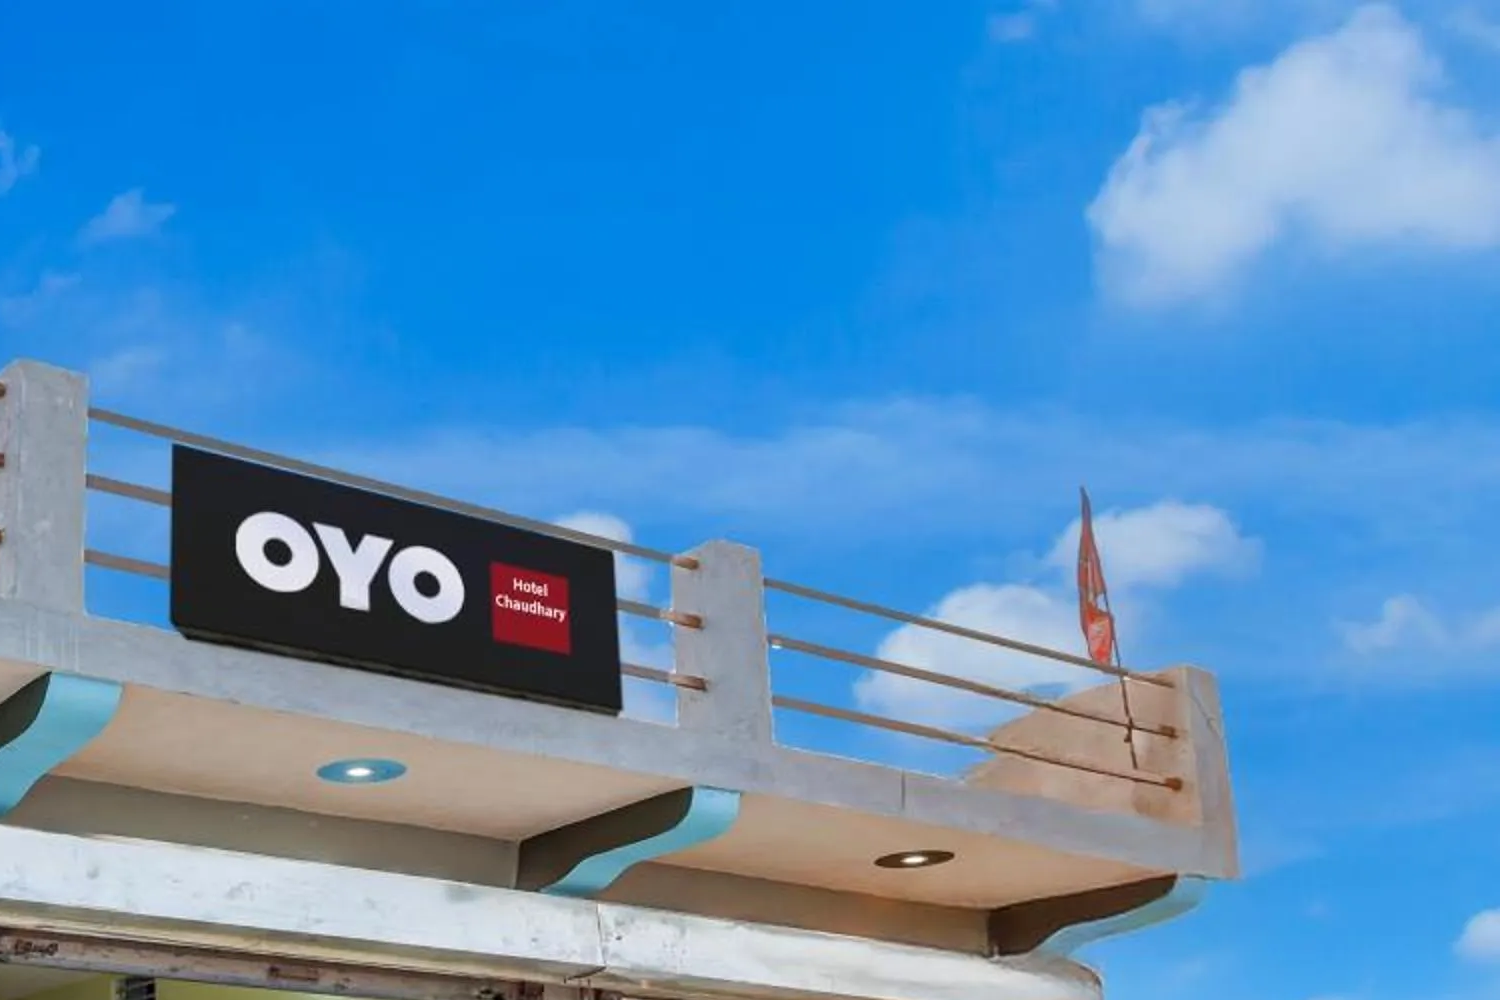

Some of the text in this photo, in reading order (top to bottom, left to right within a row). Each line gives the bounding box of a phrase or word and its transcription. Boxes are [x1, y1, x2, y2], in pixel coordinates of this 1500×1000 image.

[236, 511, 465, 624] OYO
[513, 577, 549, 597] Hotel
[495, 594, 566, 623] Chaudhary
